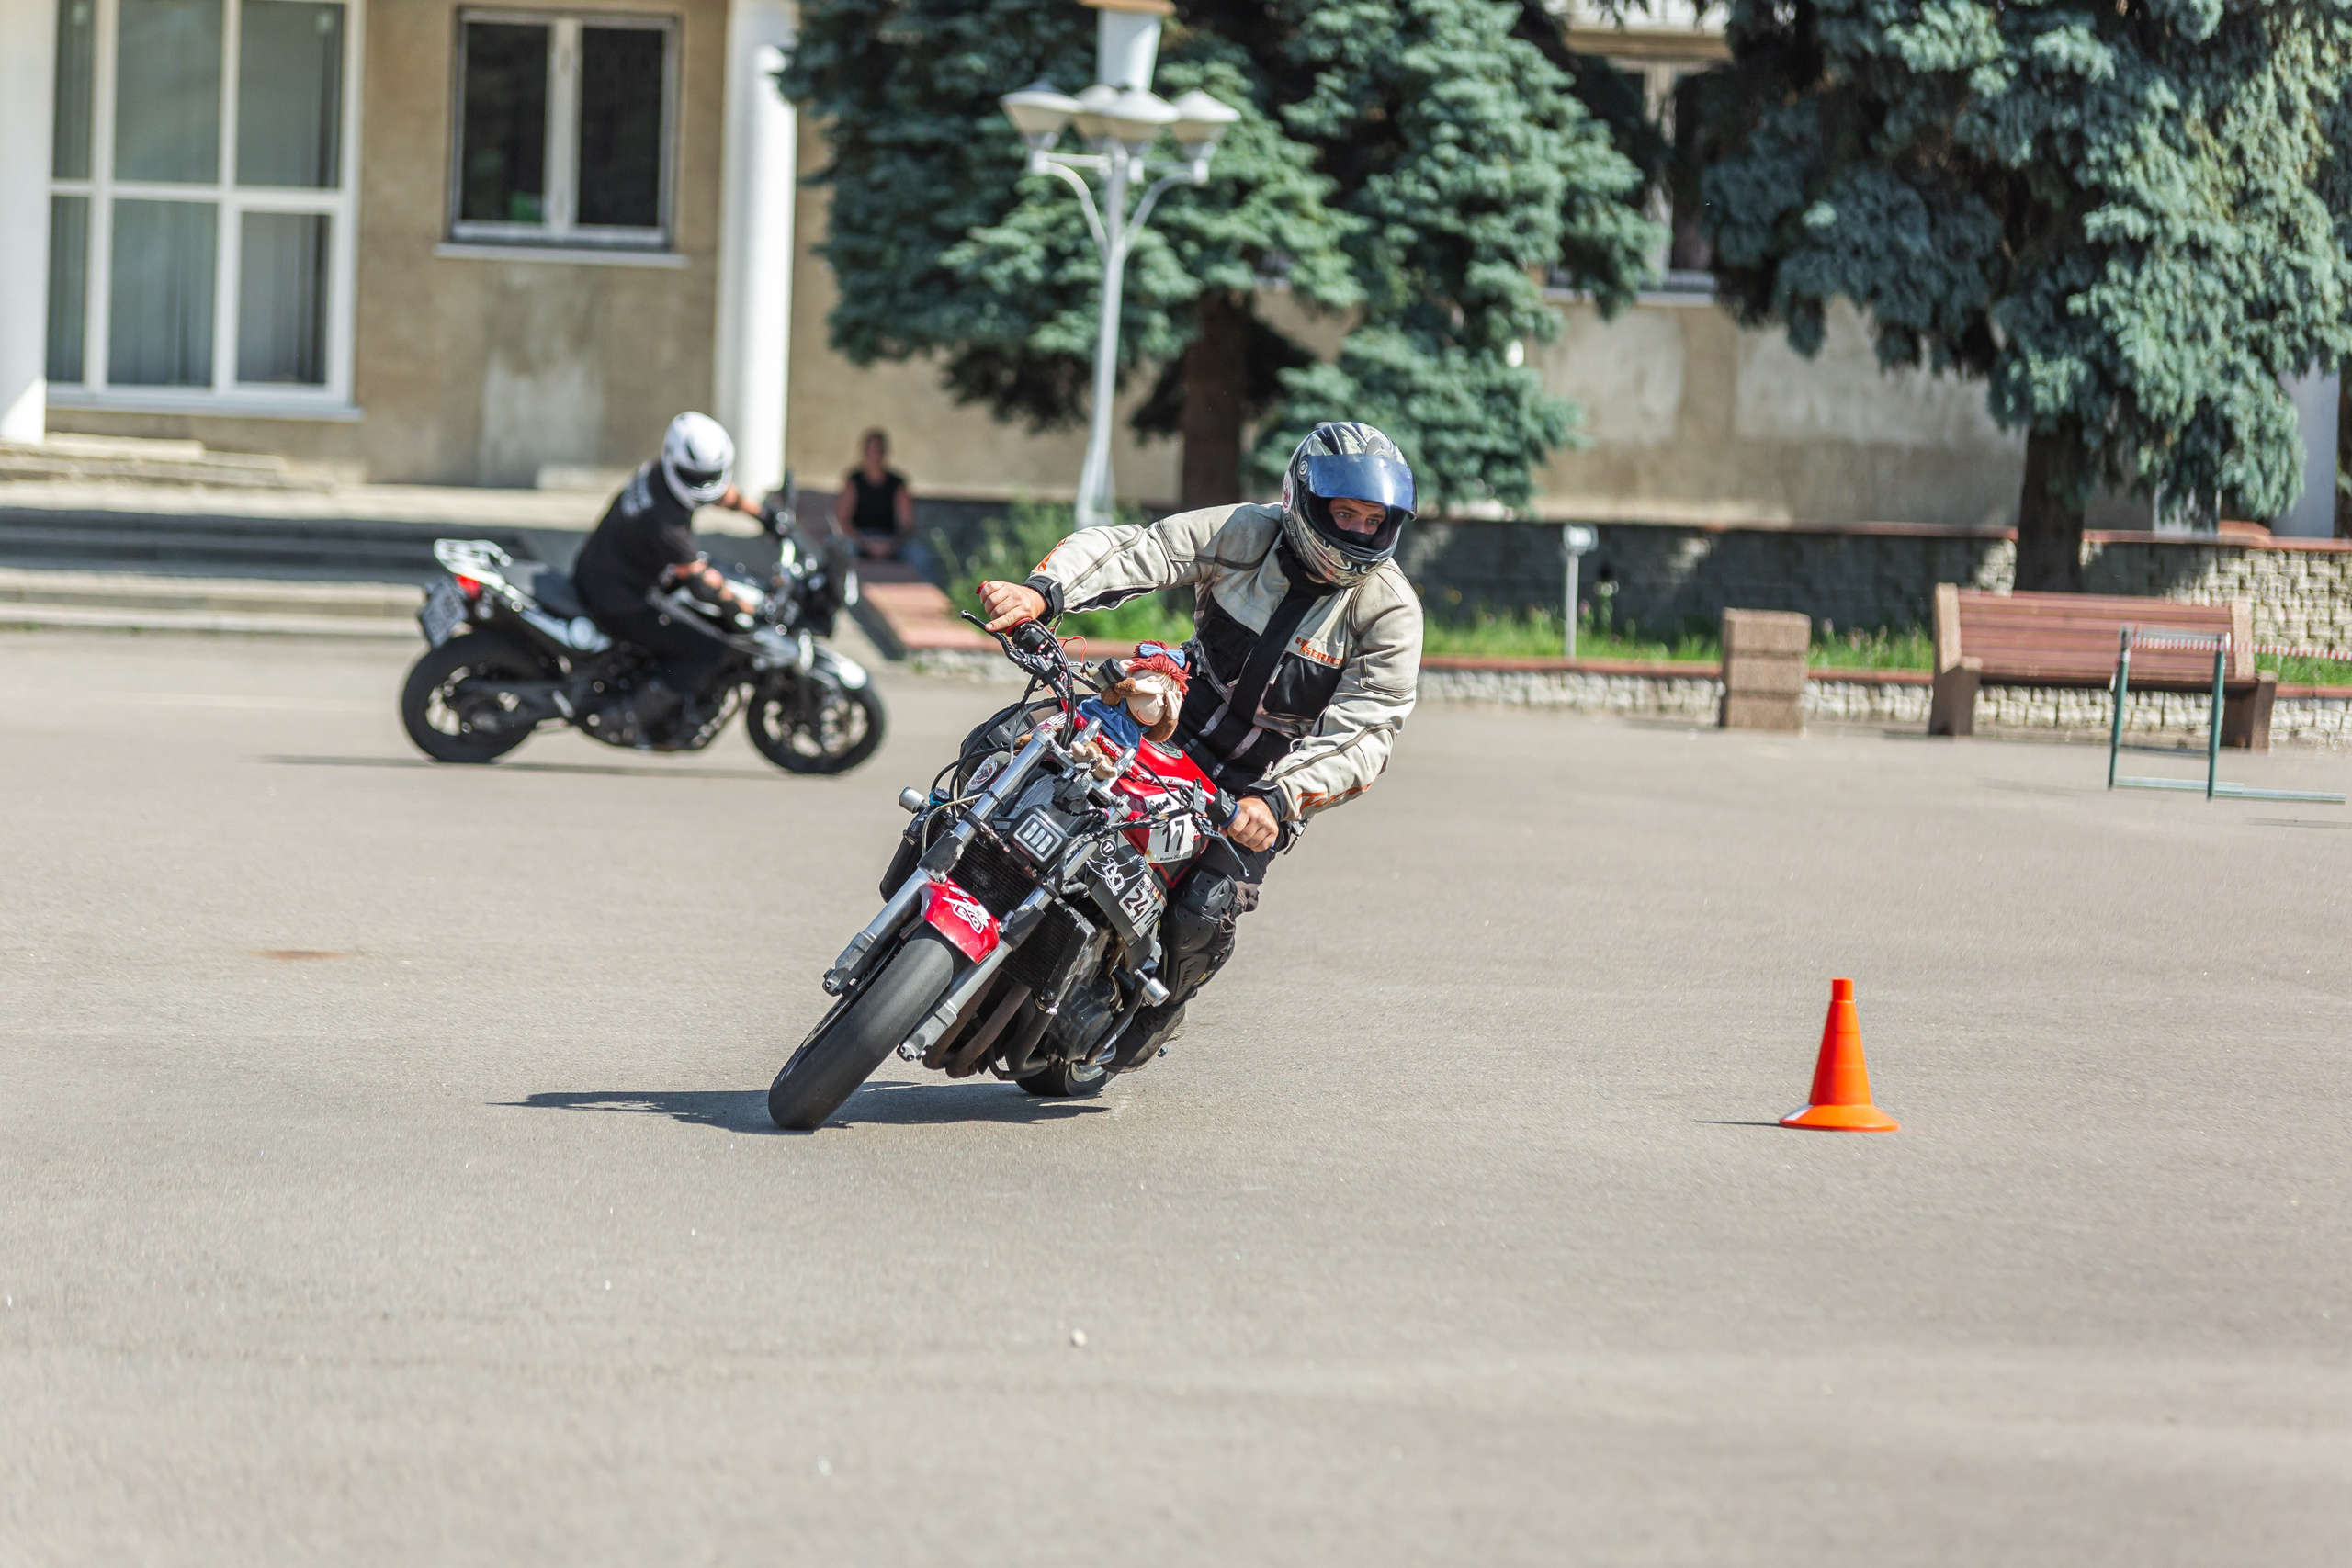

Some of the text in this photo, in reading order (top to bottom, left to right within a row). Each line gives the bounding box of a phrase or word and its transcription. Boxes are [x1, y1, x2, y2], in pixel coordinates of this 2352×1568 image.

[1103, 841, 1115, 853] 17
[1162, 819, 1185, 852] 17
[1123, 888, 1148, 918] 24
